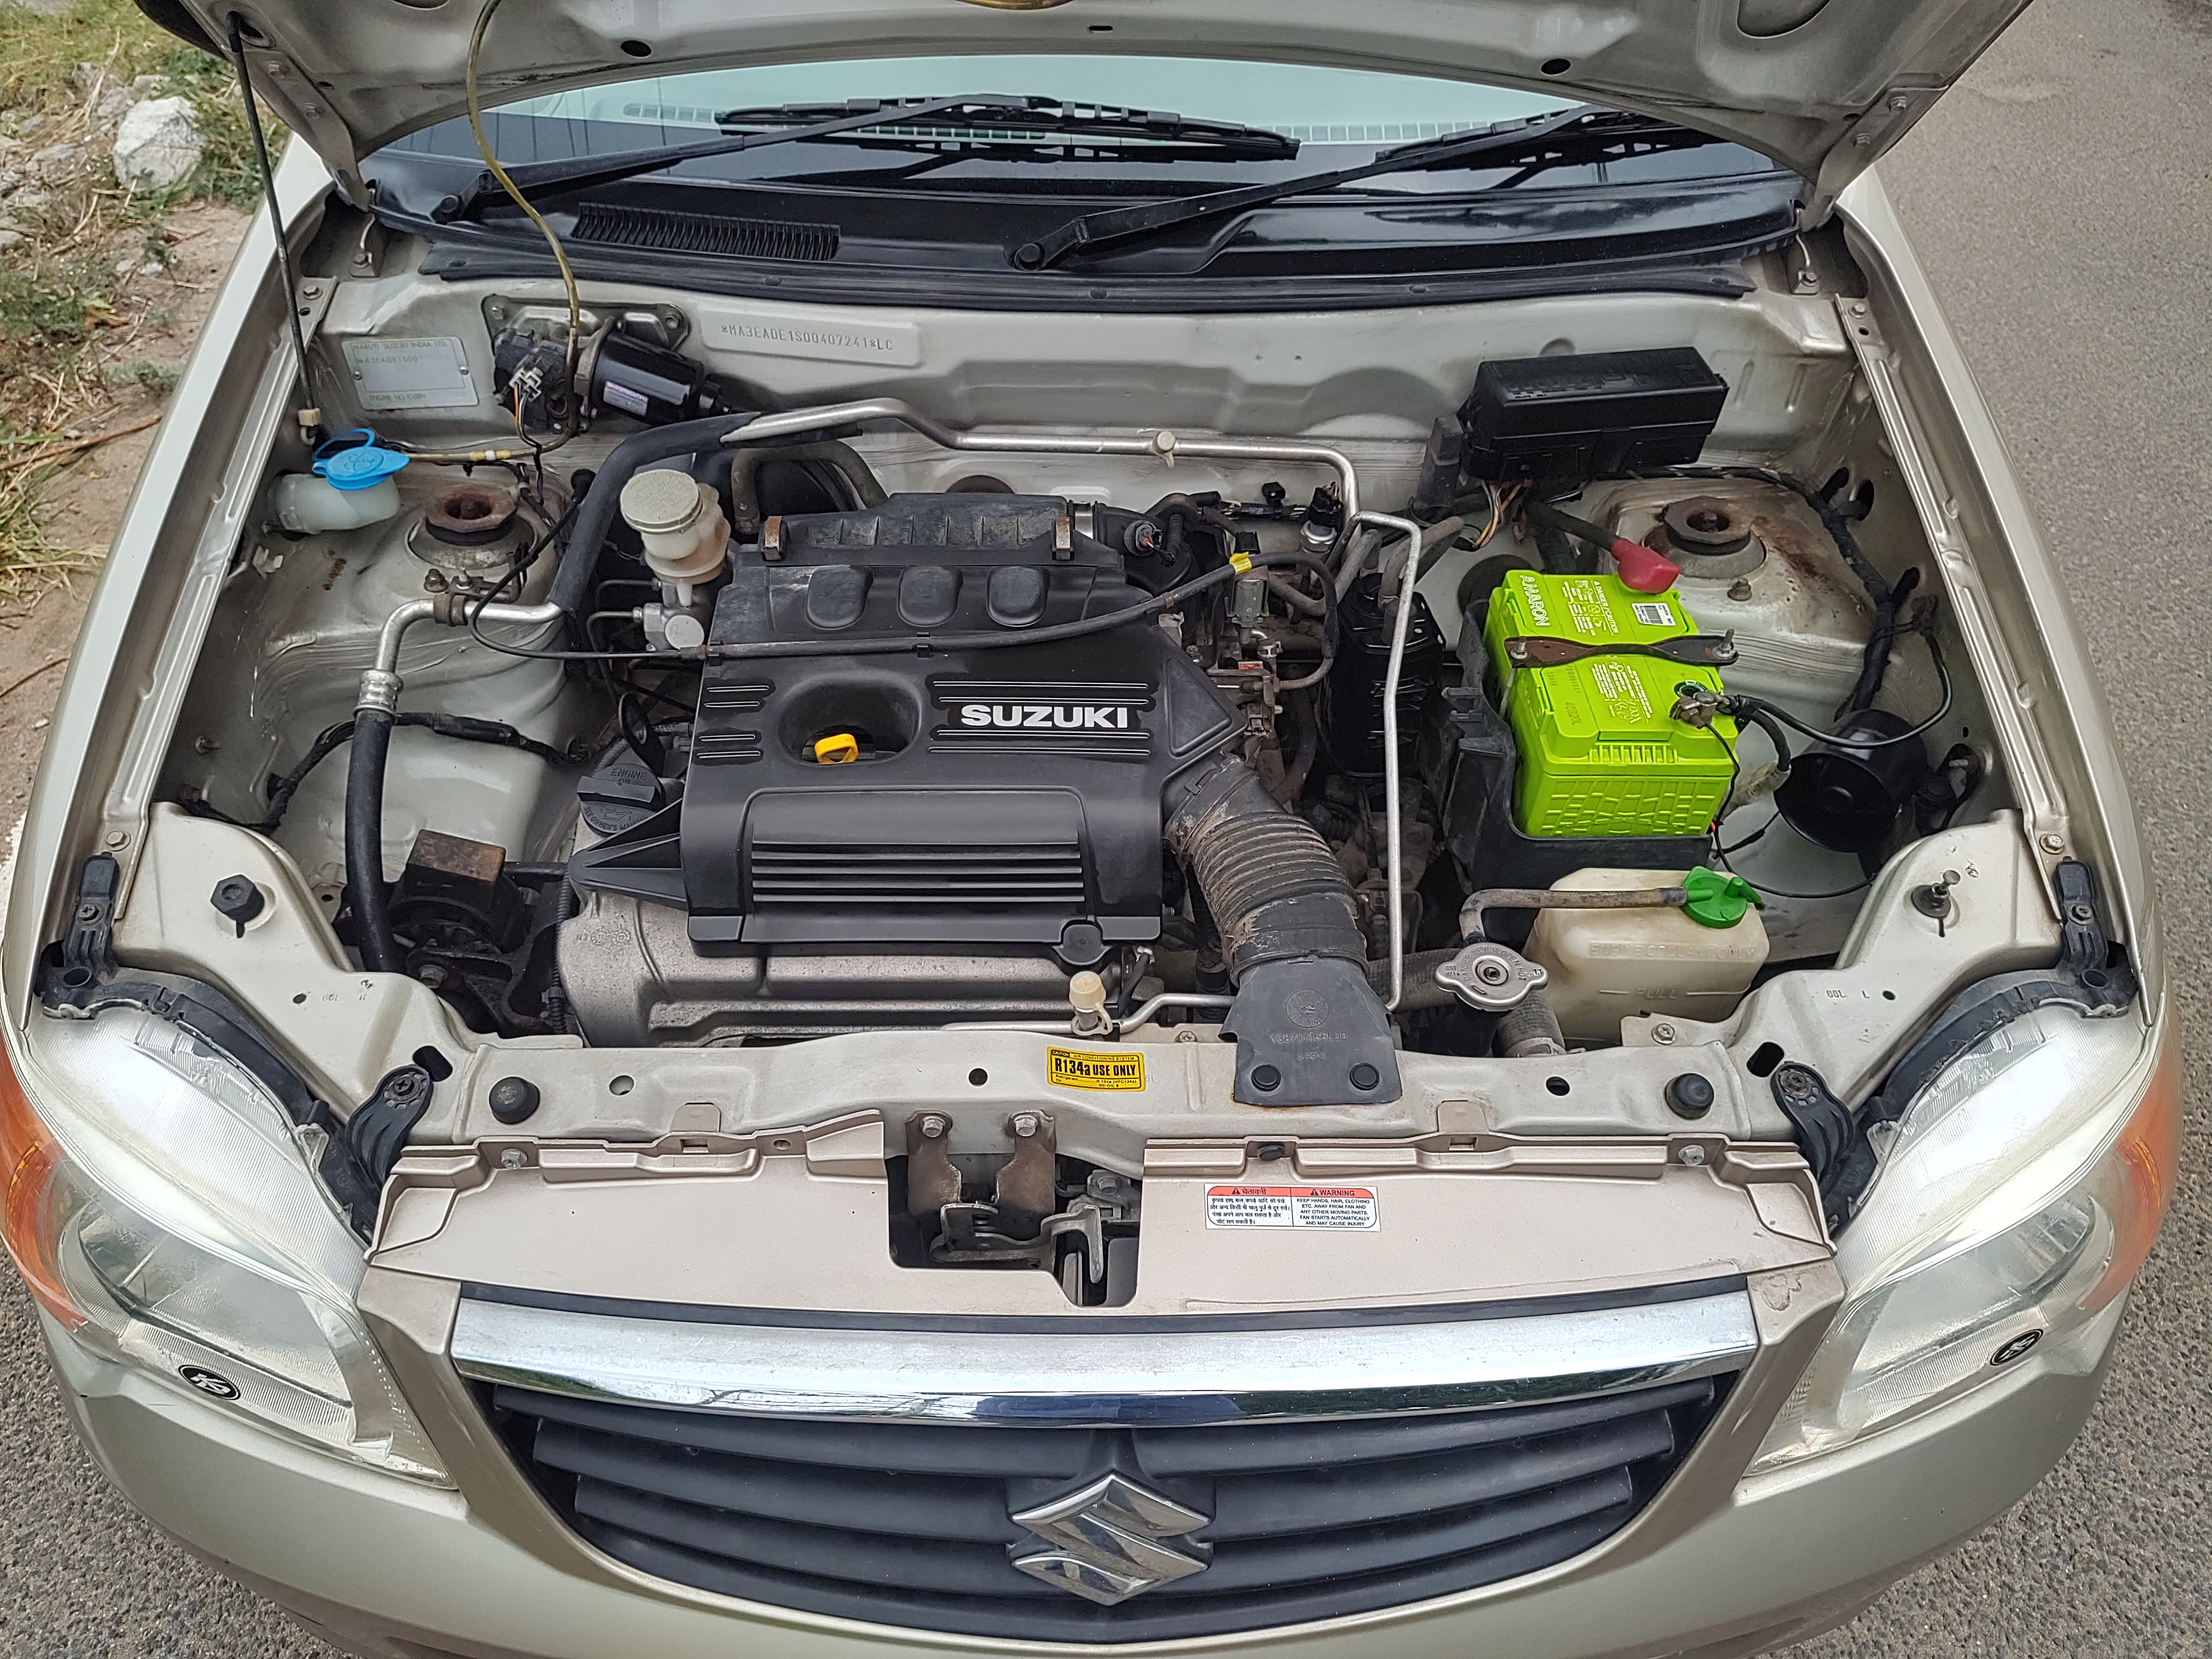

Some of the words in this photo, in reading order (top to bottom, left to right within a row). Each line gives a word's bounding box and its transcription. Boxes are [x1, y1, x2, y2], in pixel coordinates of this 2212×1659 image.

[1519, 575, 1550, 626] AMARON
[961, 705, 1128, 729] SUZUKI
[611, 768, 648, 780] ENGINE
[584, 807, 594, 820] SEE
[590, 817, 617, 831] OWNER'S
[1590, 944, 1642, 956] ENGINE
[1647, 945, 1712, 959] COOLANT
[1717, 947, 1755, 960] ONLY
[1460, 954, 1471, 981] DANGER
[1473, 946, 1498, 956] NEVER
[1501, 950, 1521, 966] OPEN
[1518, 968, 1527, 981] HOT
[1636, 988, 1677, 999] FULL
[1055, 1057, 1091, 1076] R134a
[1093, 1064, 1110, 1076] USE
[1113, 1064, 1136, 1076] ONLY
[1242, 1187, 1266, 1195] चेतावनी
